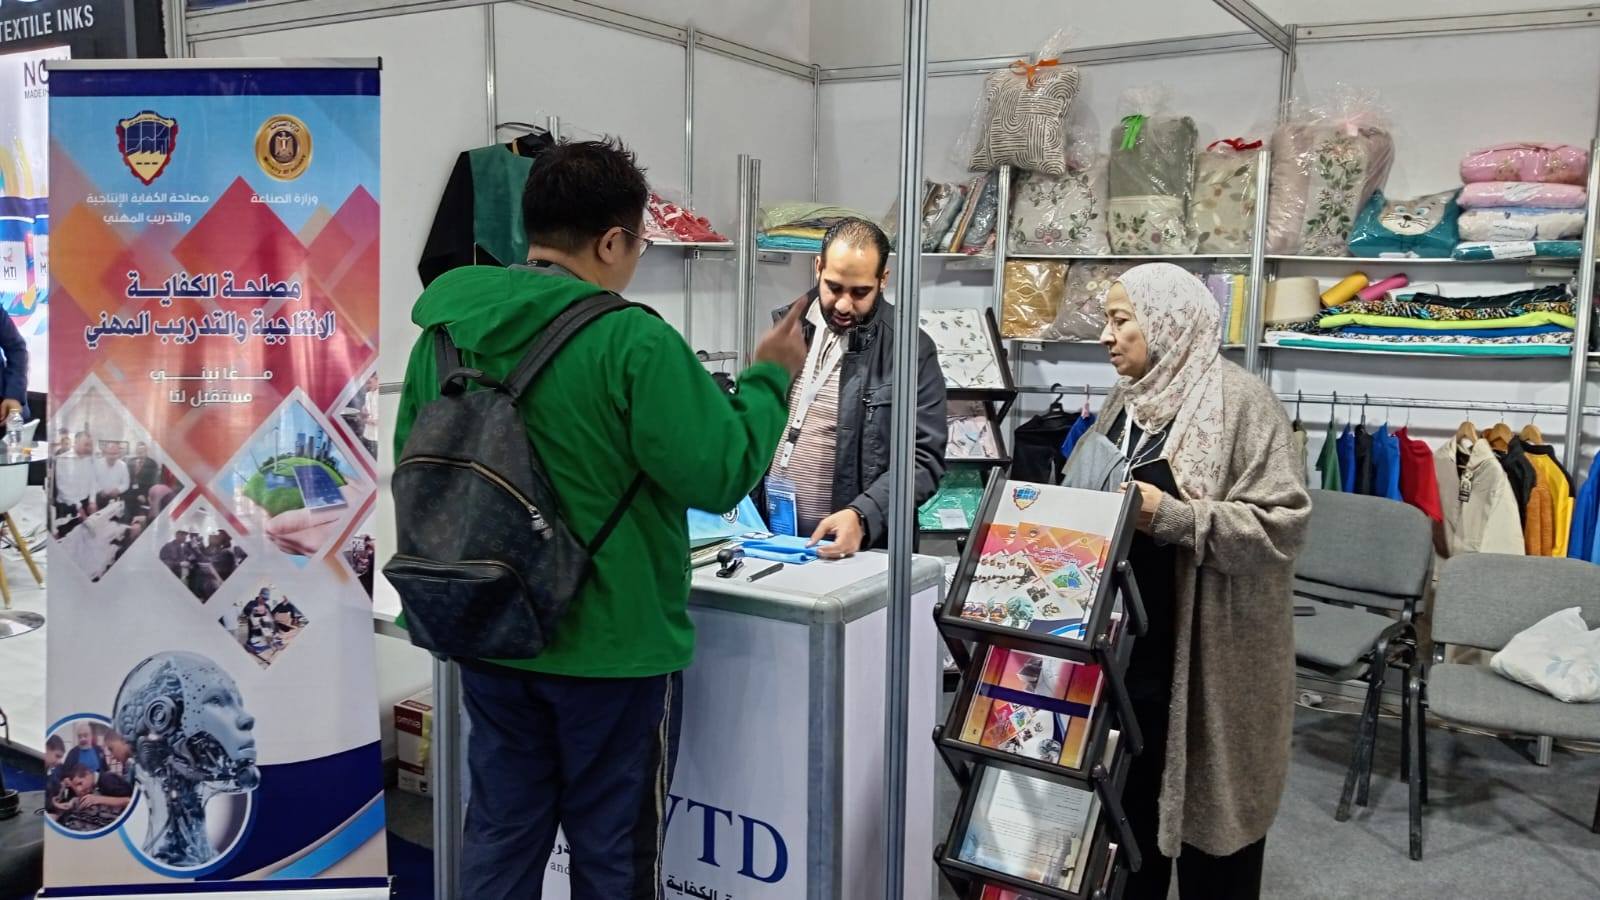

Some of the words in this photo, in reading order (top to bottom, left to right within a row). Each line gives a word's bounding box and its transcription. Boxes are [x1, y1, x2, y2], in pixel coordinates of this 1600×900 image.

[0, 12, 53, 43] TEXTILE
[57, 4, 94, 32] INKS
[131, 191, 167, 206] الكفاية
[169, 191, 209, 203] مصلحة
[250, 193, 292, 204] الصناعة
[294, 193, 319, 206] وزارة
[103, 211, 144, 225] المهني
[146, 212, 192, 225] والتدريب
[4, 266, 17, 278] MTI
[85, 310, 150, 349] المهني
[154, 311, 248, 345] والتدريب
[169, 389, 186, 403] لنا
[190, 389, 253, 407] مستقبل
[666, 874, 717, 900] الكفاية
